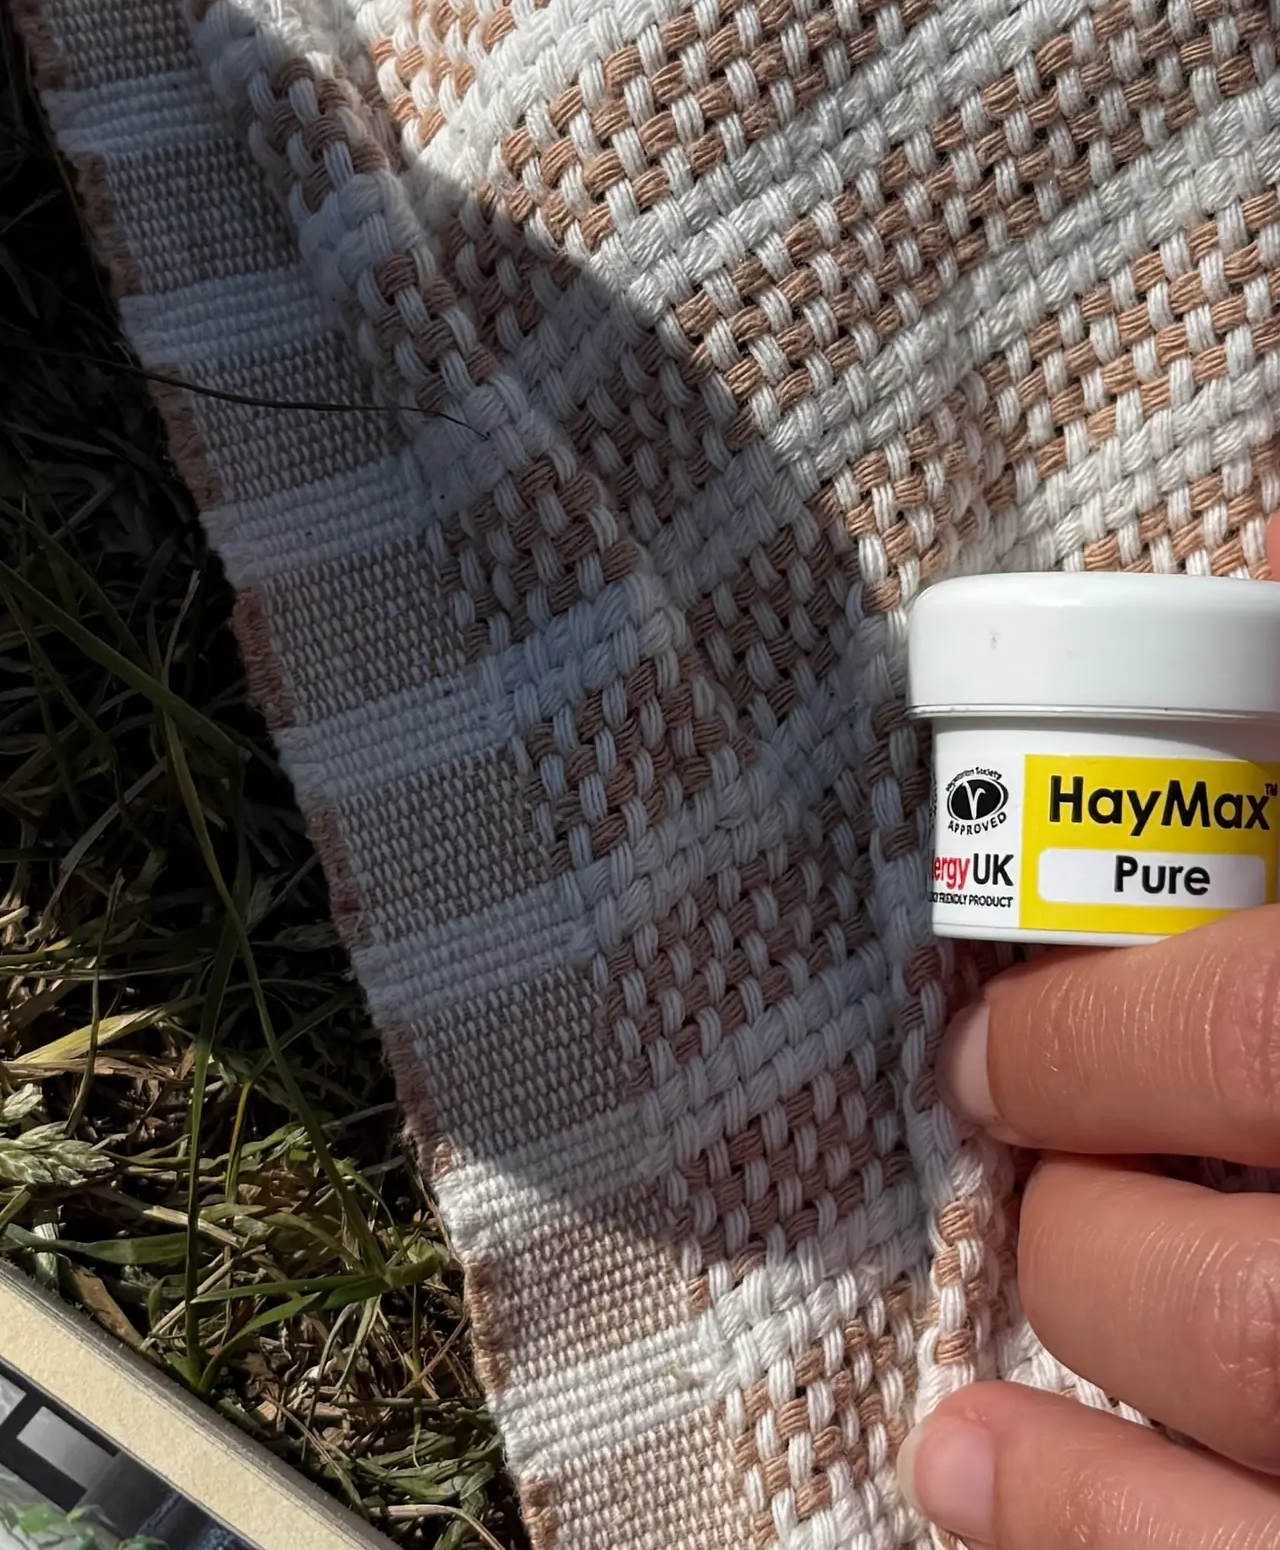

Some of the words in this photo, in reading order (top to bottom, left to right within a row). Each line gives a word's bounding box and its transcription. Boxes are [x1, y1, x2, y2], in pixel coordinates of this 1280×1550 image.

[947, 811, 1007, 836] APPROVED
[931, 852, 970, 891] ergy
[973, 852, 1015, 887] UK
[1114, 854, 1211, 896] Pure
[968, 894, 1014, 909] PRODUCT
